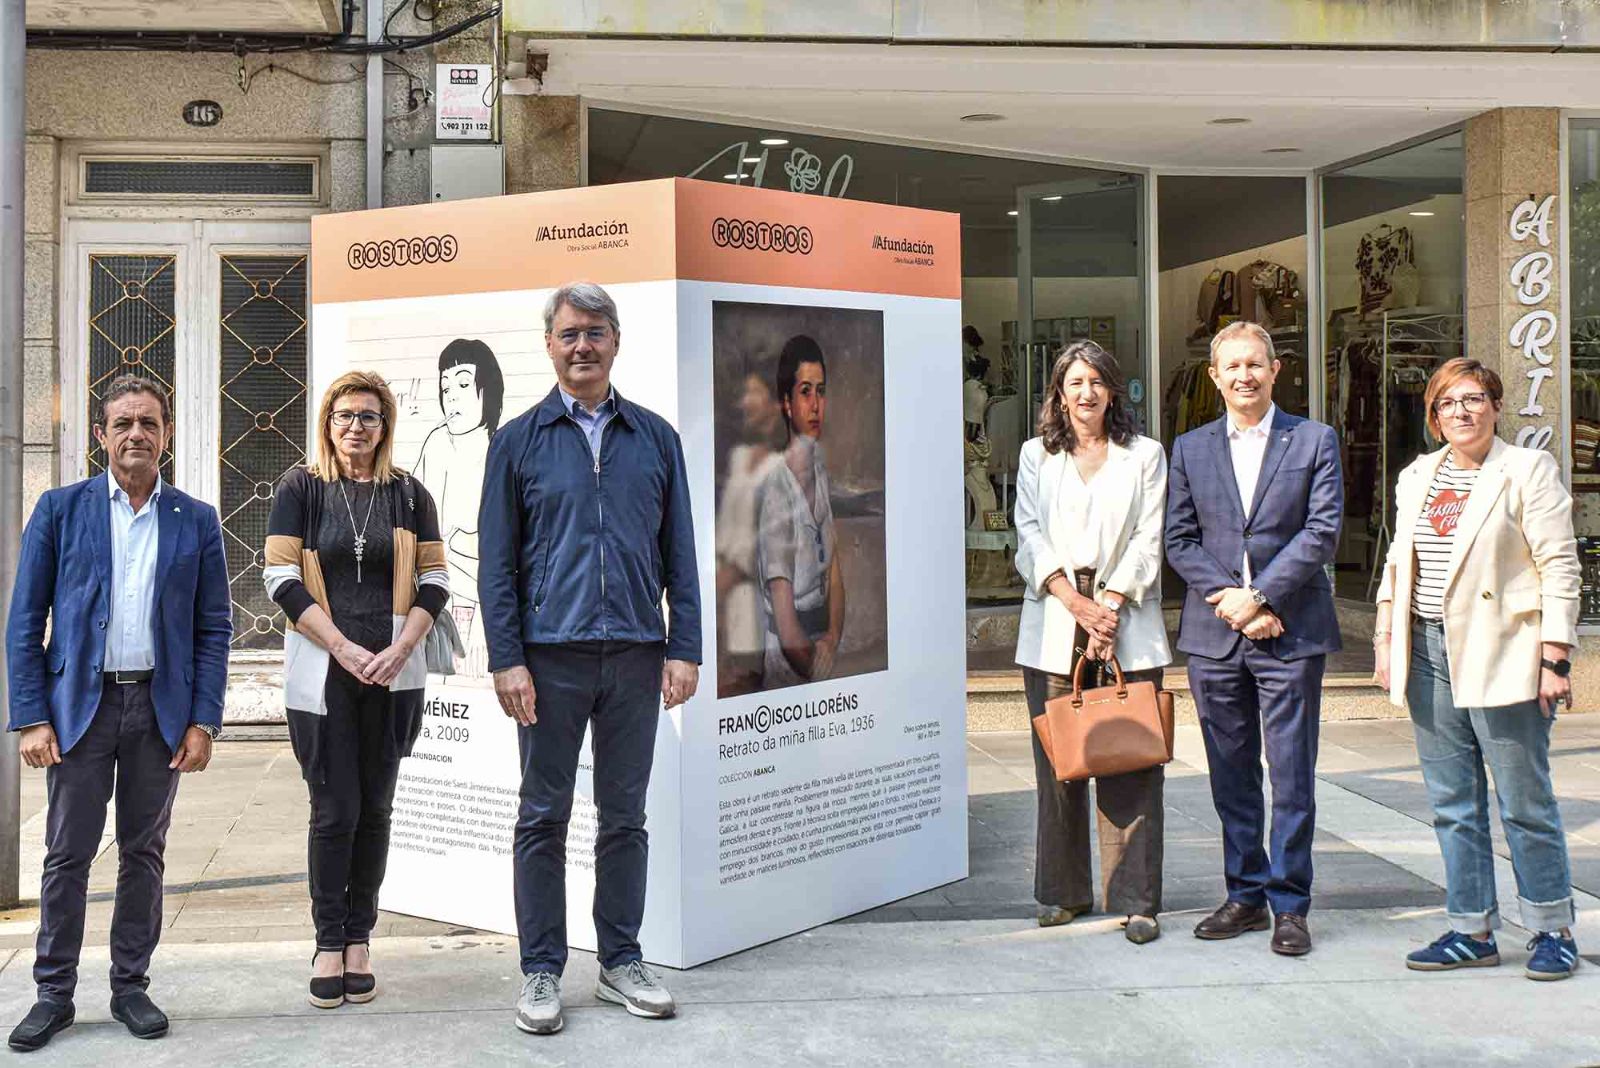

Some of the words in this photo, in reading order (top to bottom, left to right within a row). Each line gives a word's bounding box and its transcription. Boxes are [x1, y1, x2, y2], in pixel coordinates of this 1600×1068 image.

[193, 106, 214, 122] 16
[598, 239, 629, 249] ABANCA
[714, 220, 811, 252] ROSTROS
[350, 236, 456, 268] ROSTROS
[424, 697, 470, 720] MÉNEZ
[806, 692, 858, 719] LLORÉNS
[437, 725, 470, 742] 2009
[719, 740, 760, 760] Retrato
[763, 736, 776, 750] da
[779, 730, 805, 748] miña
[808, 726, 825, 741] filla
[851, 714, 874, 732] 1936
[719, 770, 752, 785] COLECCIÓN
[753, 765, 775, 776] ABANCA
